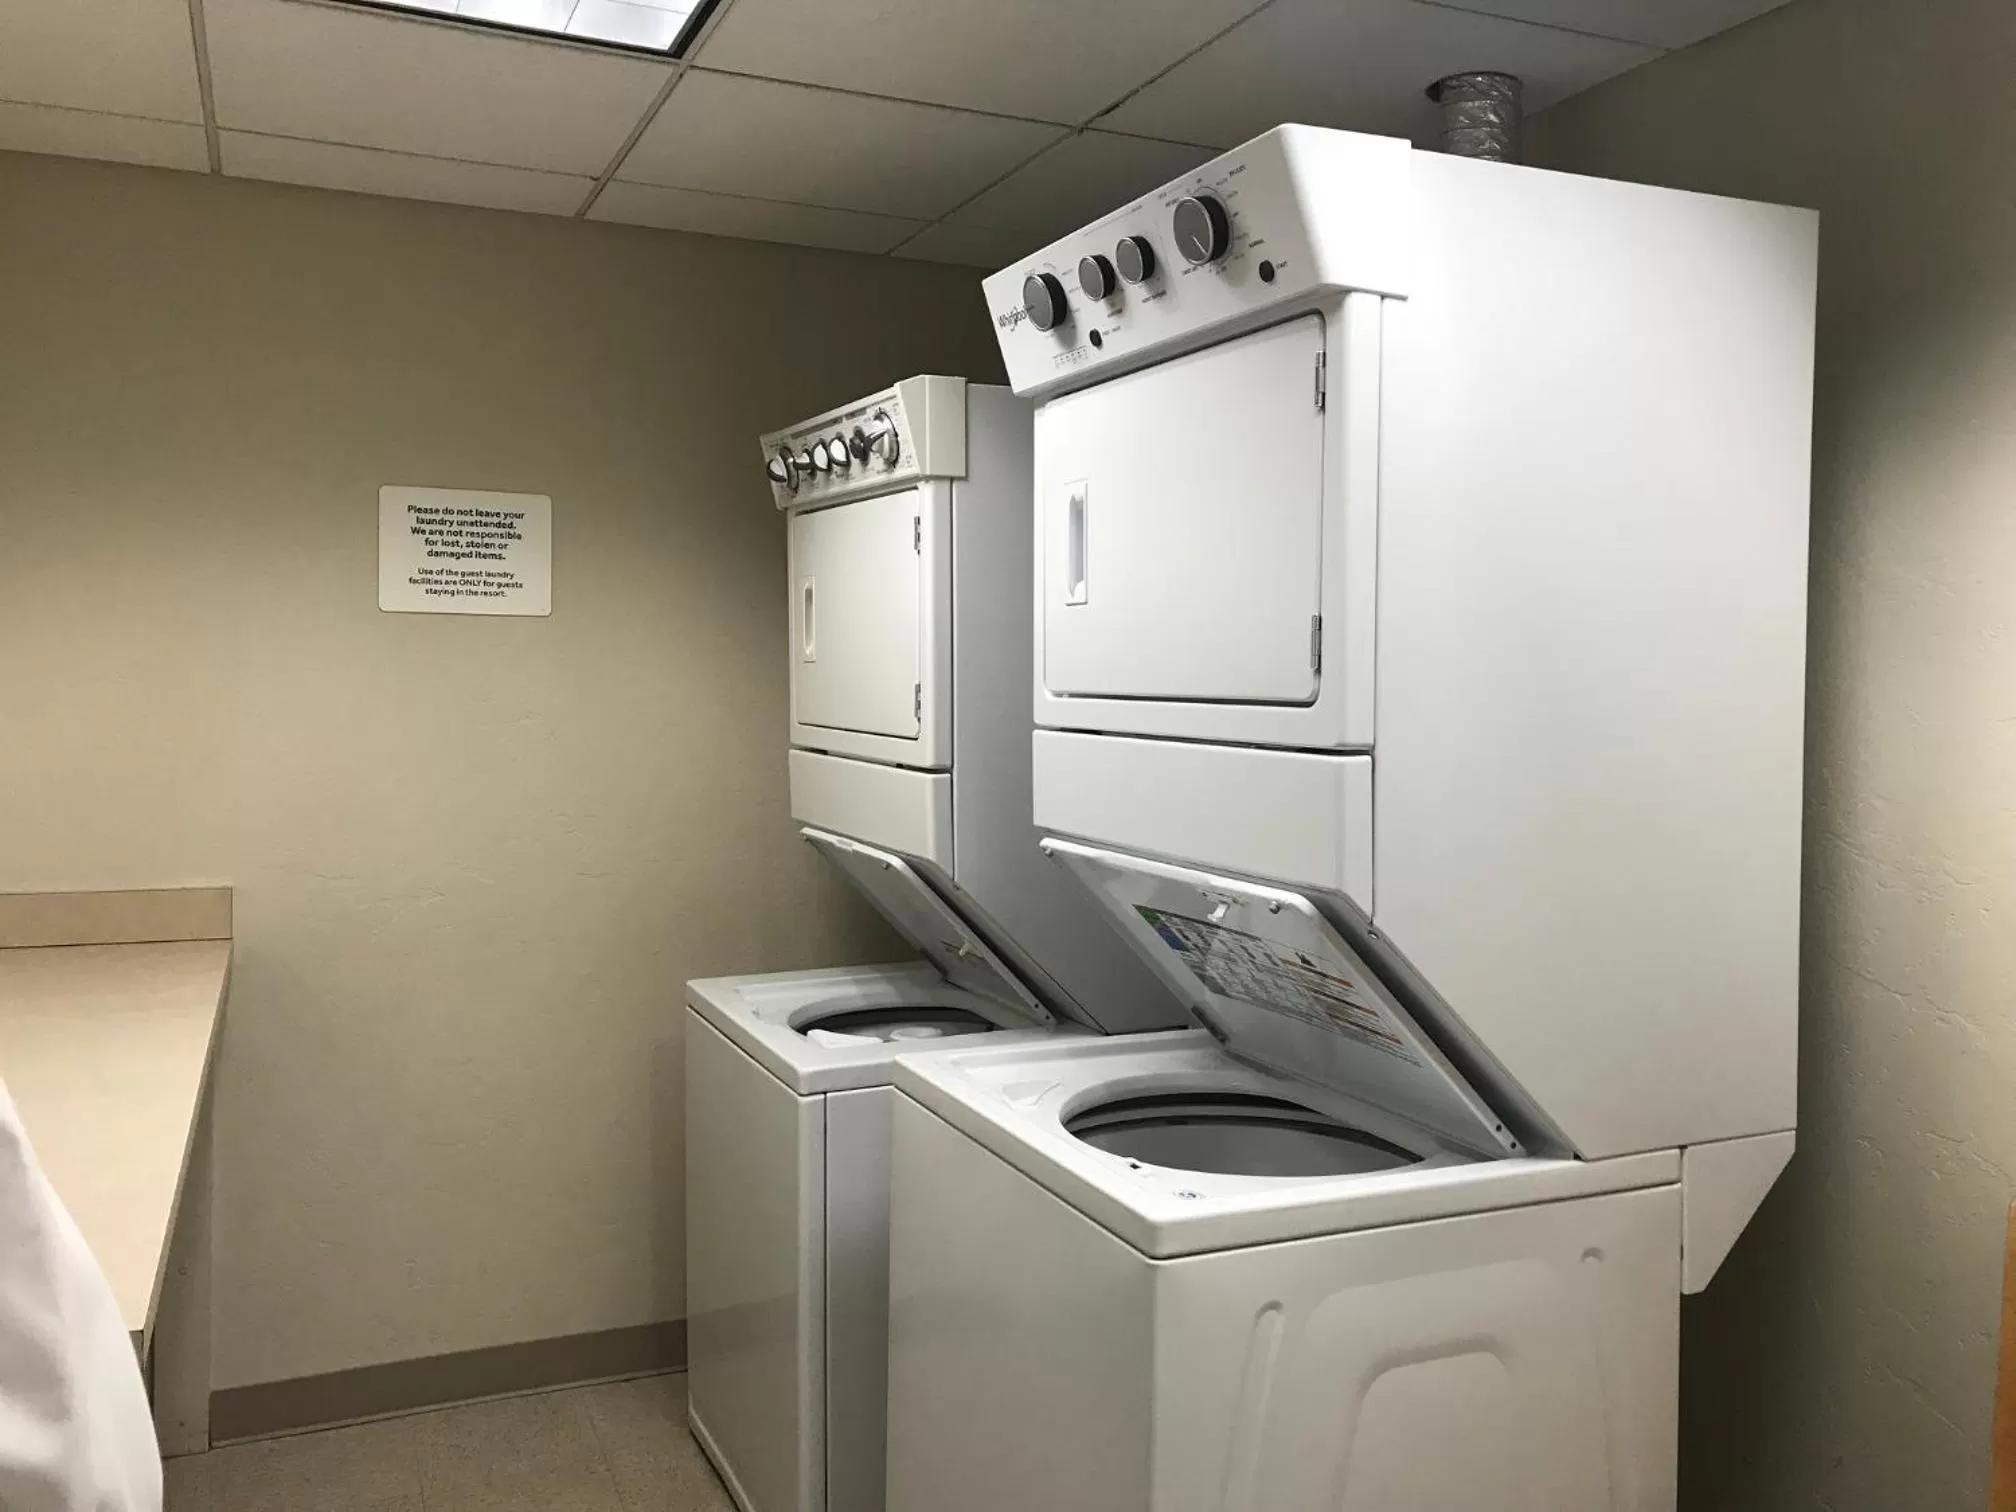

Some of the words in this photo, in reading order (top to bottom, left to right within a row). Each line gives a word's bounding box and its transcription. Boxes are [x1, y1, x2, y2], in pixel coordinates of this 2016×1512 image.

[407, 505, 440, 514] Please
[442, 507, 455, 515] do
[457, 508, 473, 516] not
[476, 509, 501, 518] leave
[503, 511, 525, 520] your
[416, 517, 454, 527] laundry
[457, 519, 516, 529] unattended.
[411, 526, 426, 535] We
[465, 530, 522, 541] responsible
[425, 537, 439, 546] for
[441, 539, 463, 549] lost,
[465, 540, 495, 549] stolen
[427, 549, 472, 560] damaged
[475, 550, 506, 560] items.
[435, 568, 443, 576] of
[461, 571, 483, 579] guest
[485, 571, 514, 579] laundry
[409, 577, 442, 586] facilities
[459, 579, 481, 587] ONLY
[483, 580, 494, 588] for
[425, 588, 455, 597] staying
[480, 590, 507, 598] resort.
